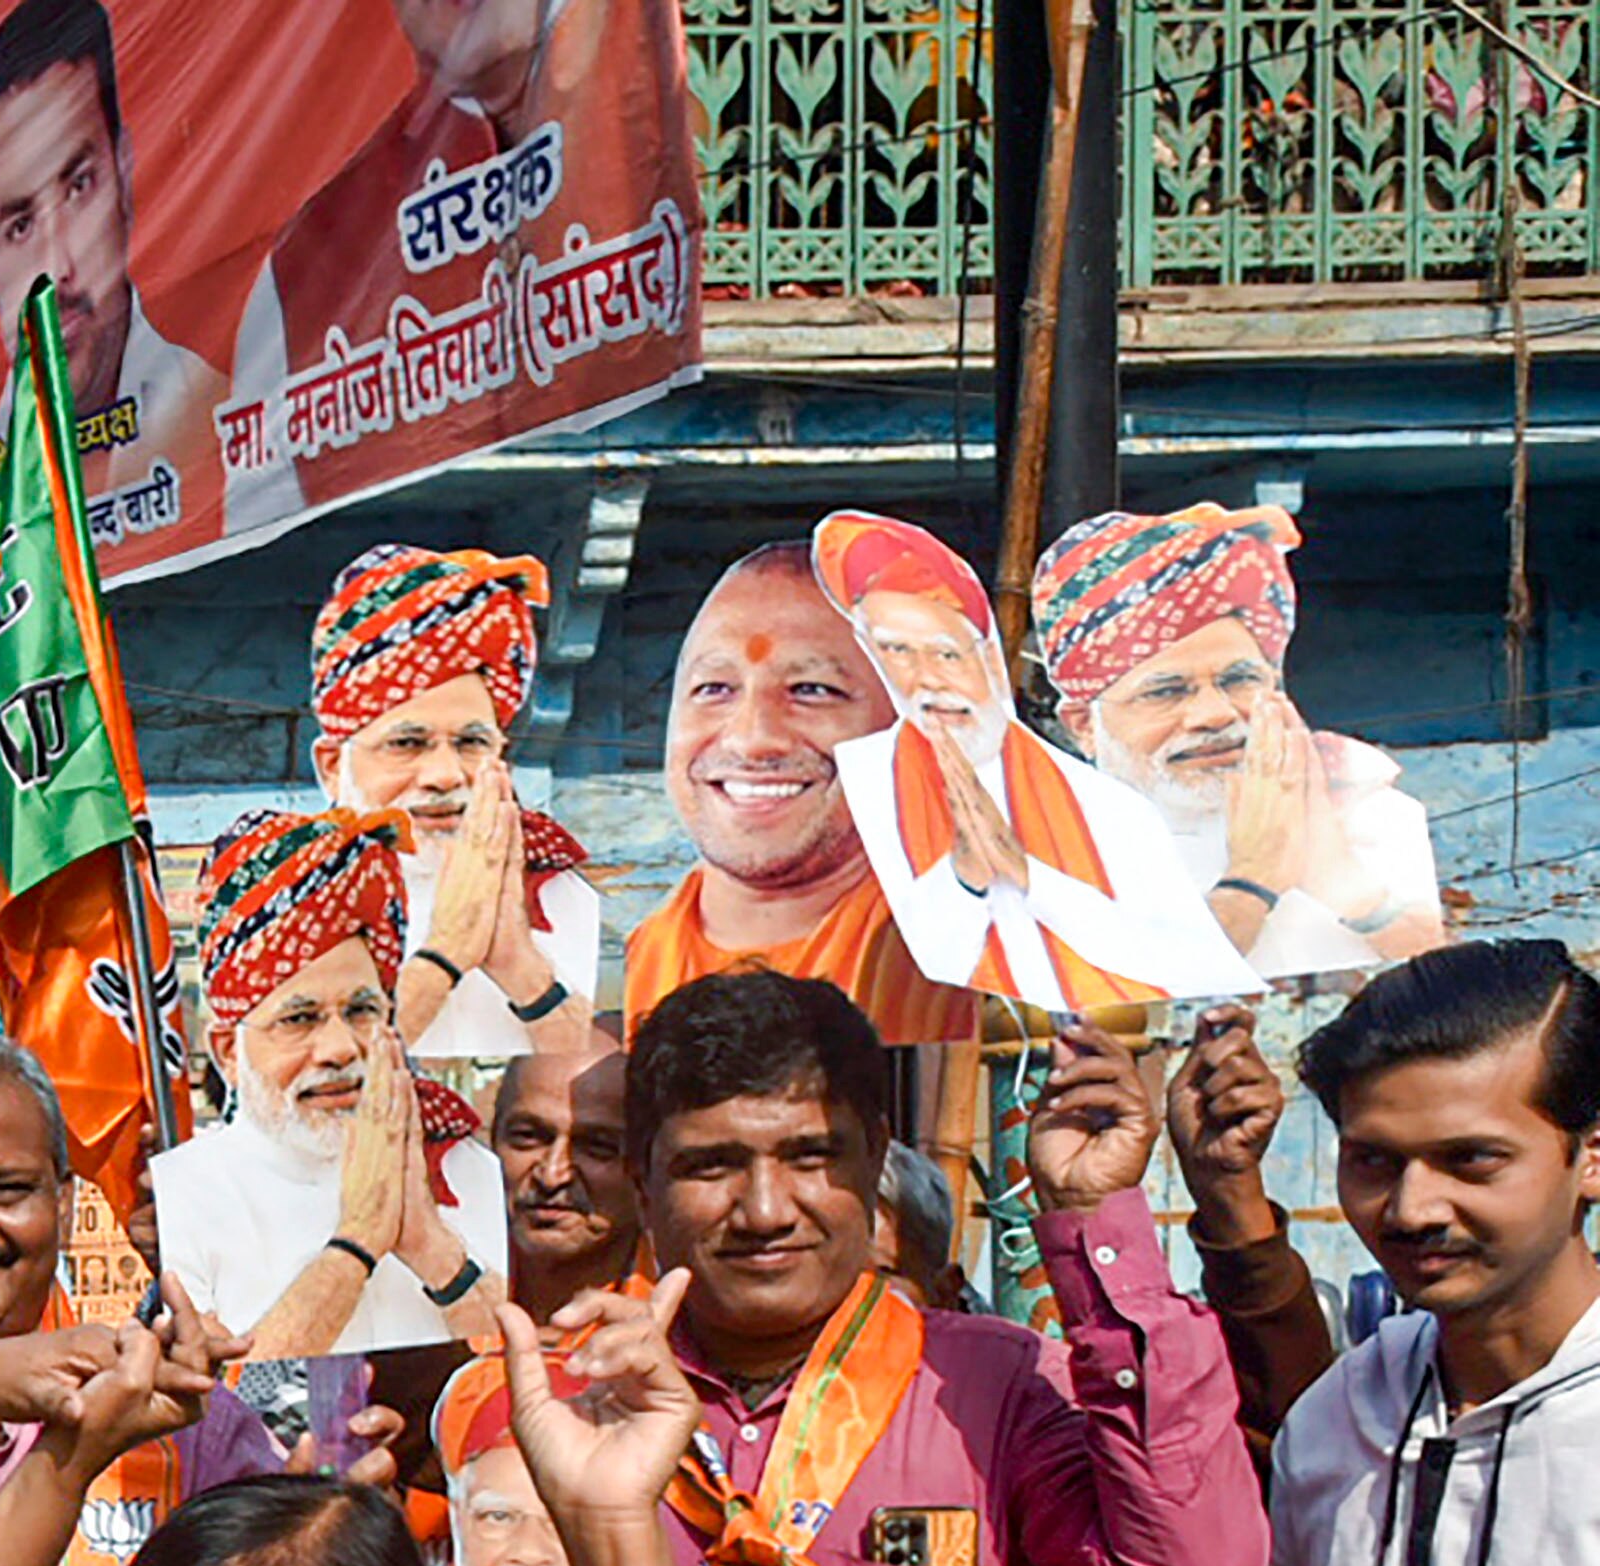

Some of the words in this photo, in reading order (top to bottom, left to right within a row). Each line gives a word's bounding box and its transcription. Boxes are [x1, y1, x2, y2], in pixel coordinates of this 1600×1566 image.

[402, 163, 557, 267] संरक्षक
[218, 399, 276, 471] मा.
[285, 334, 388, 449] मनोज
[396, 266, 512, 416] तिवारी
[522, 206, 685, 378] (सांसद)
